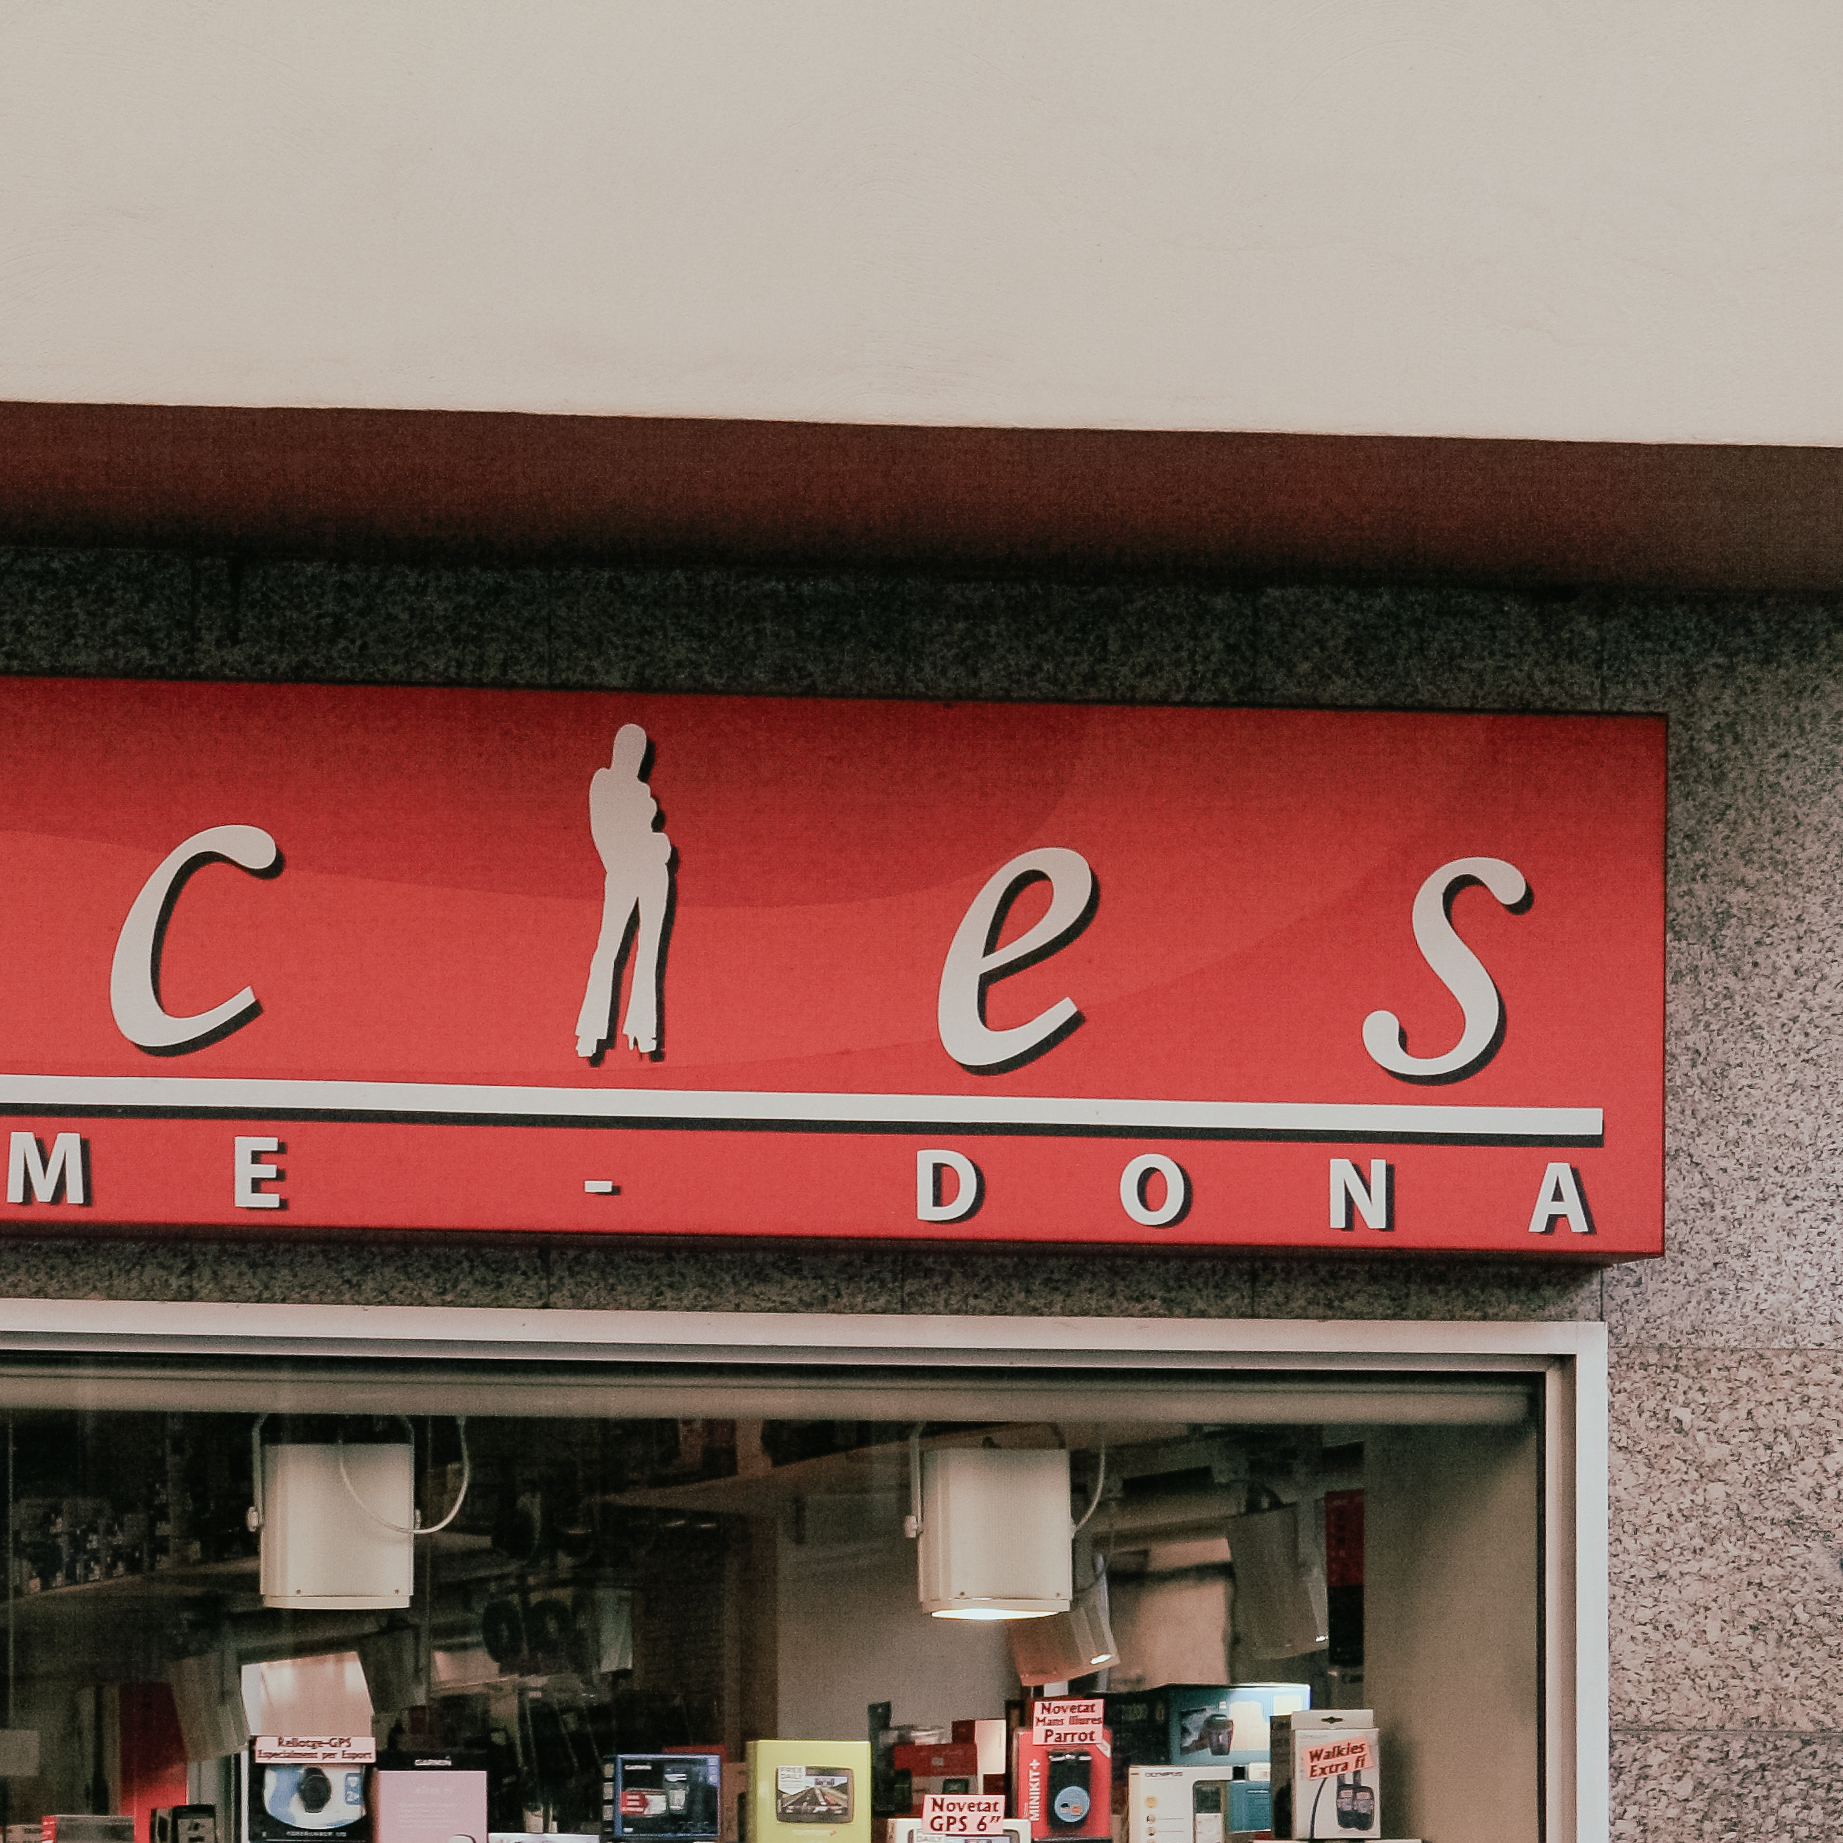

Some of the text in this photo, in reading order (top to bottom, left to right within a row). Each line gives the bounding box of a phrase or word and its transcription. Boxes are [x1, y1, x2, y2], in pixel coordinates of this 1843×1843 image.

[915, 1149, 1589, 1233] DONA
[1041, 1702, 1095, 1716] Novetat
[1044, 1729, 1095, 1744] Parrot
[1309, 1742, 1366, 1763] Walkies
[1028, 1758, 1040, 1821] MINIKIT+
[932, 1798, 998, 1814] Novetat
